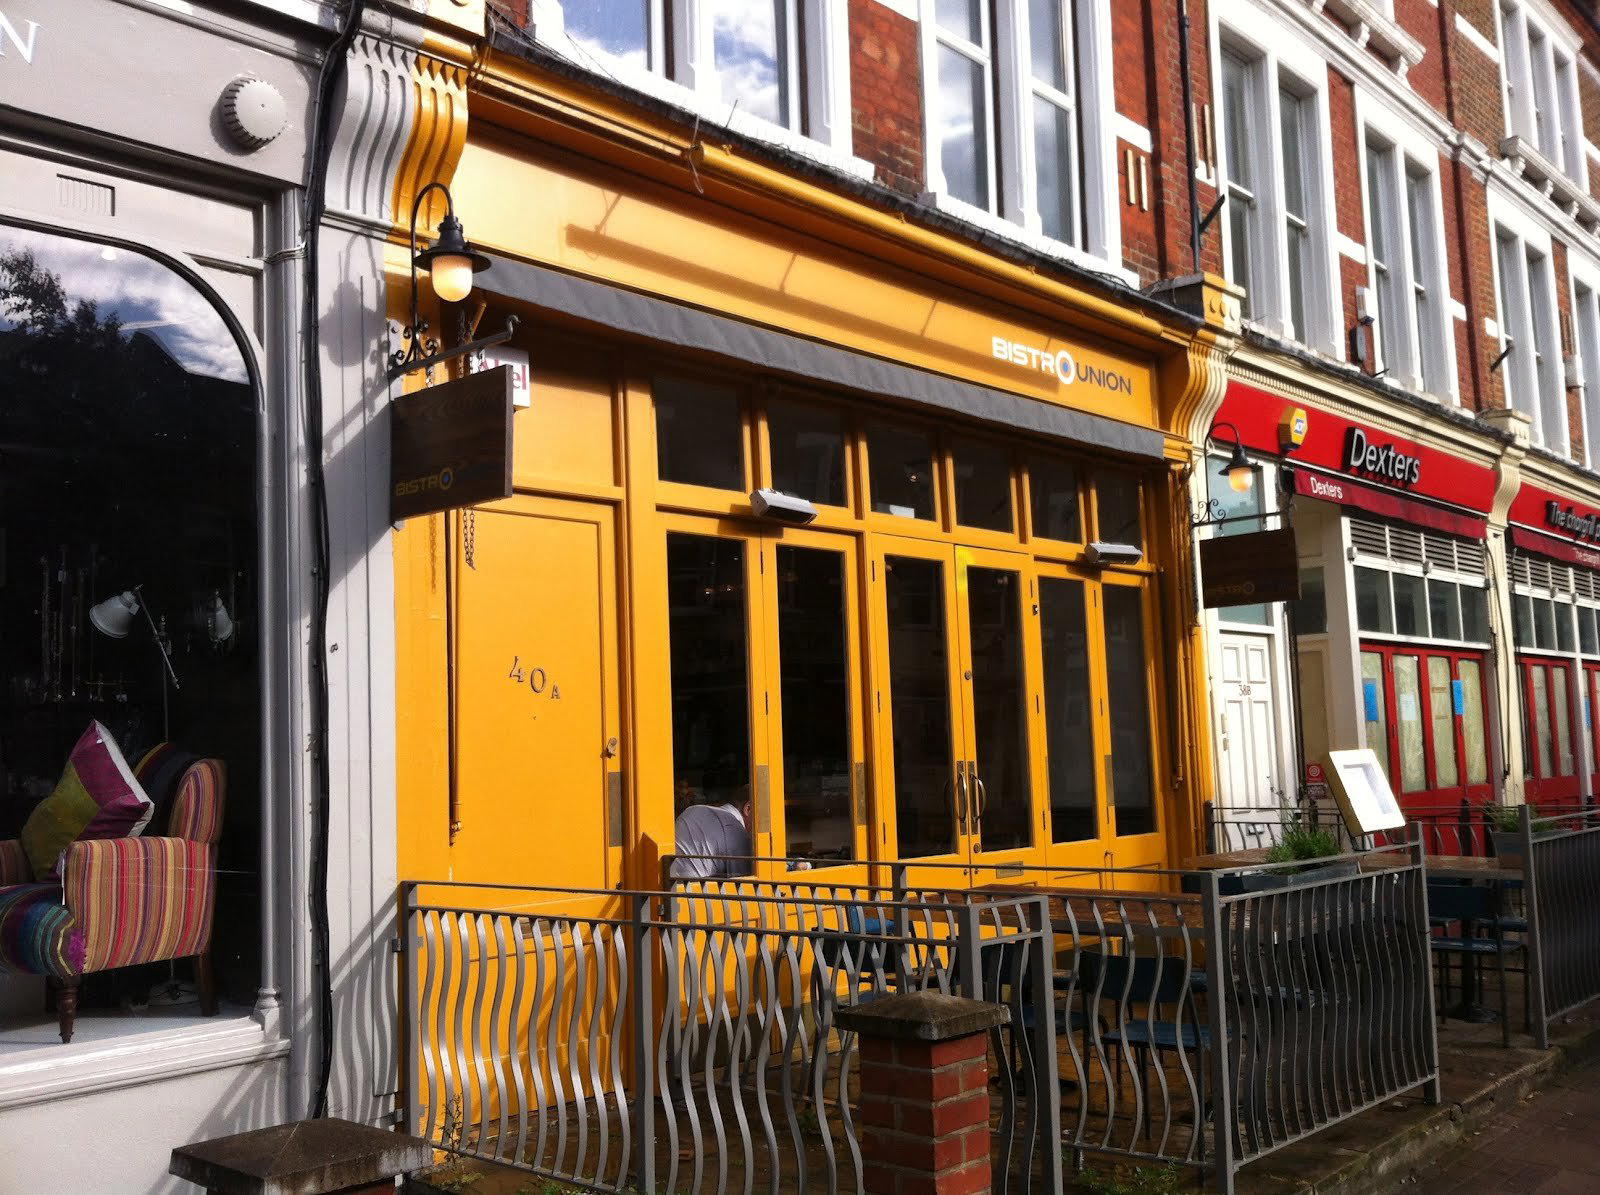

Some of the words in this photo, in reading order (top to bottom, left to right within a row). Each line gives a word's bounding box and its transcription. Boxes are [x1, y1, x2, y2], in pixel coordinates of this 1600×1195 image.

[0, 10, 41, 64] N
[992, 336, 1075, 384] BISTRO
[1076, 362, 1132, 396] UNION
[1350, 428, 1421, 484] Dexters
[1310, 477, 1343, 500] Dexters
